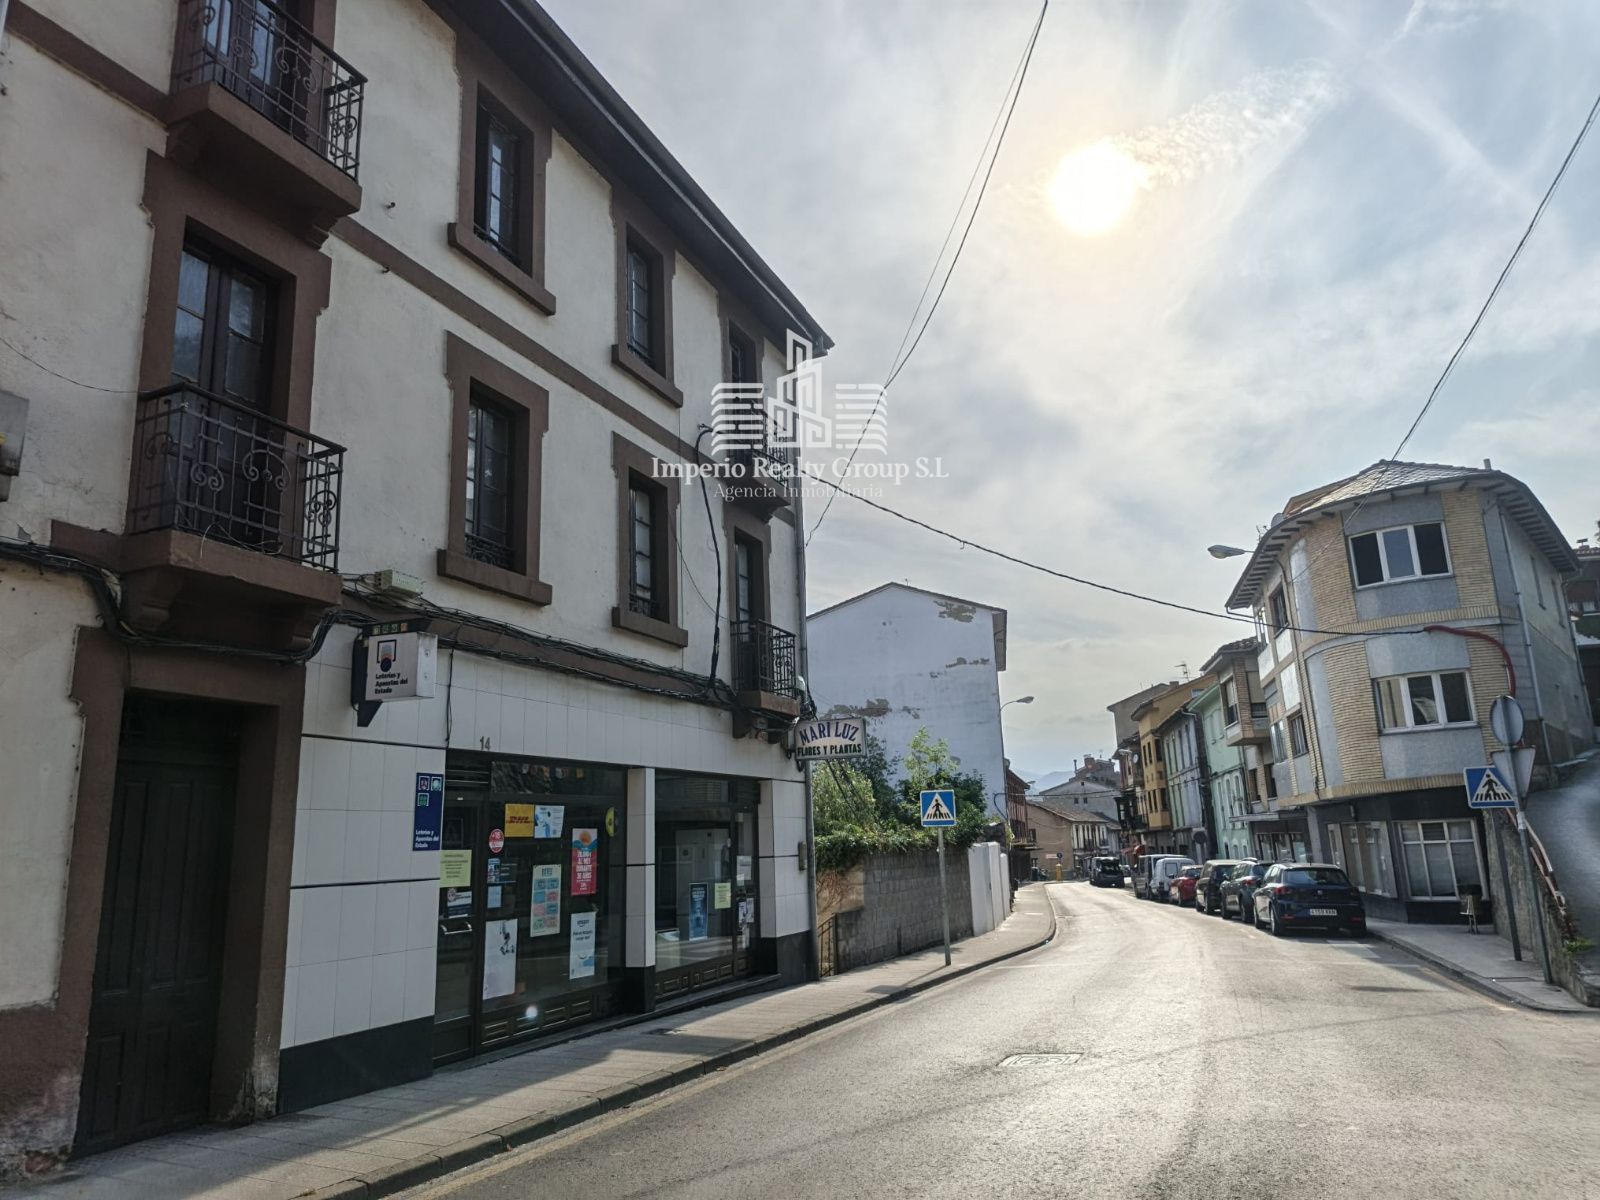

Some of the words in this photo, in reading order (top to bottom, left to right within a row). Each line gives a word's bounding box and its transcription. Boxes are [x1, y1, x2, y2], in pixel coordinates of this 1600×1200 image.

[799, 722, 831, 746] MARI
[835, 721, 860, 742] LUZ
[479, 735, 491, 751] 14
[797, 746, 821, 757] FLORES
[821, 746, 828, 755] Y
[830, 743, 862, 755] PLANTAS
